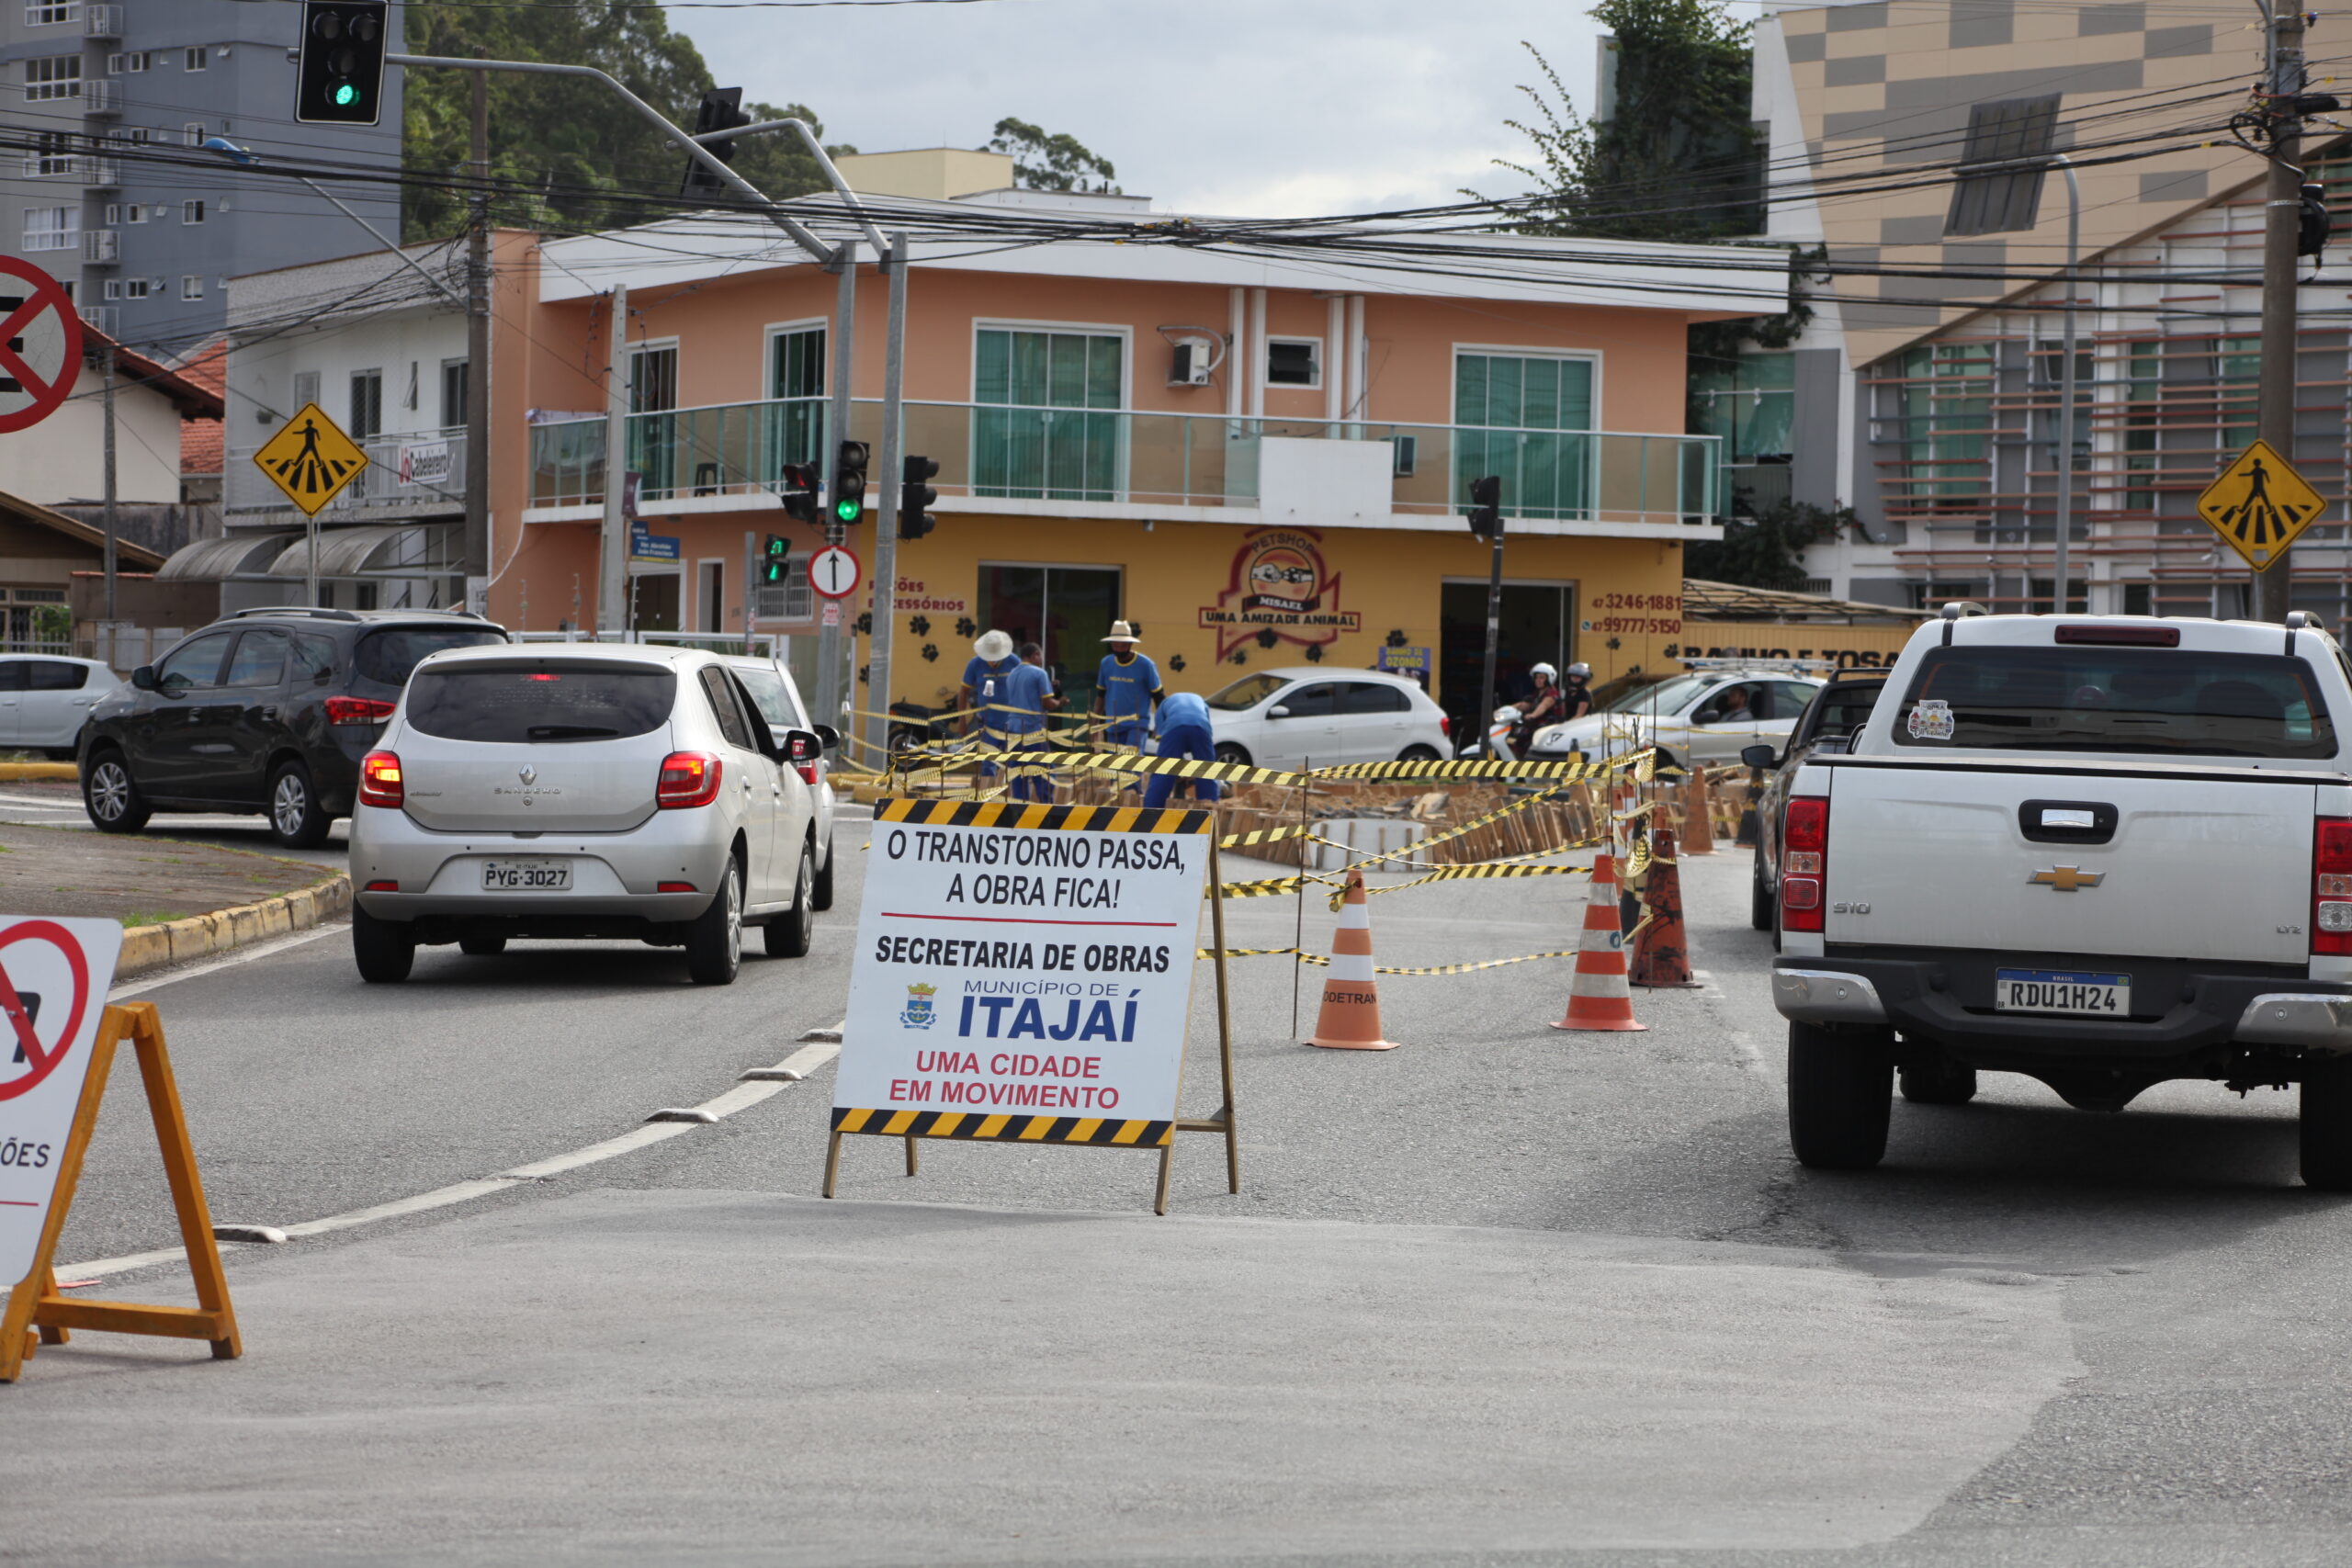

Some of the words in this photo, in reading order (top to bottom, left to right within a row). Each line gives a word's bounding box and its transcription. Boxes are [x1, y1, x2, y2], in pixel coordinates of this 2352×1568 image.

[1259, 596, 1304, 611] MISAEL
[1205, 612, 1237, 624] UMA
[1241, 614, 1300, 626] AMIZADE
[1303, 615, 1355, 626] ANIMAL
[888, 829, 907, 860] O
[915, 829, 1091, 869] TRANSTORNO
[1097, 838, 1185, 874] PASSA,
[945, 873, 965, 903] A
[973, 874, 1046, 906] OBRA
[1054, 877, 1121, 908] FICA!
[1833, 901, 1871, 914] S10
[875, 934, 1034, 971] SECRETARIA
[1042, 944, 1076, 971] DE
[1083, 944, 1170, 973] OBRAS
[964, 979, 1082, 996] MUNICÍPIO
[1090, 983, 1119, 997] DE
[2010, 982, 2117, 1011] RDU1H24
[958, 988, 1142, 1043] ITAJAÍ
[915, 1050, 980, 1075] UMA
[989, 1053, 1102, 1079] CIDADE
[888, 1079, 932, 1102] EM
[940, 1081, 1119, 1110] MOVIMENTO
[0, 1136, 51, 1168] ÕES
